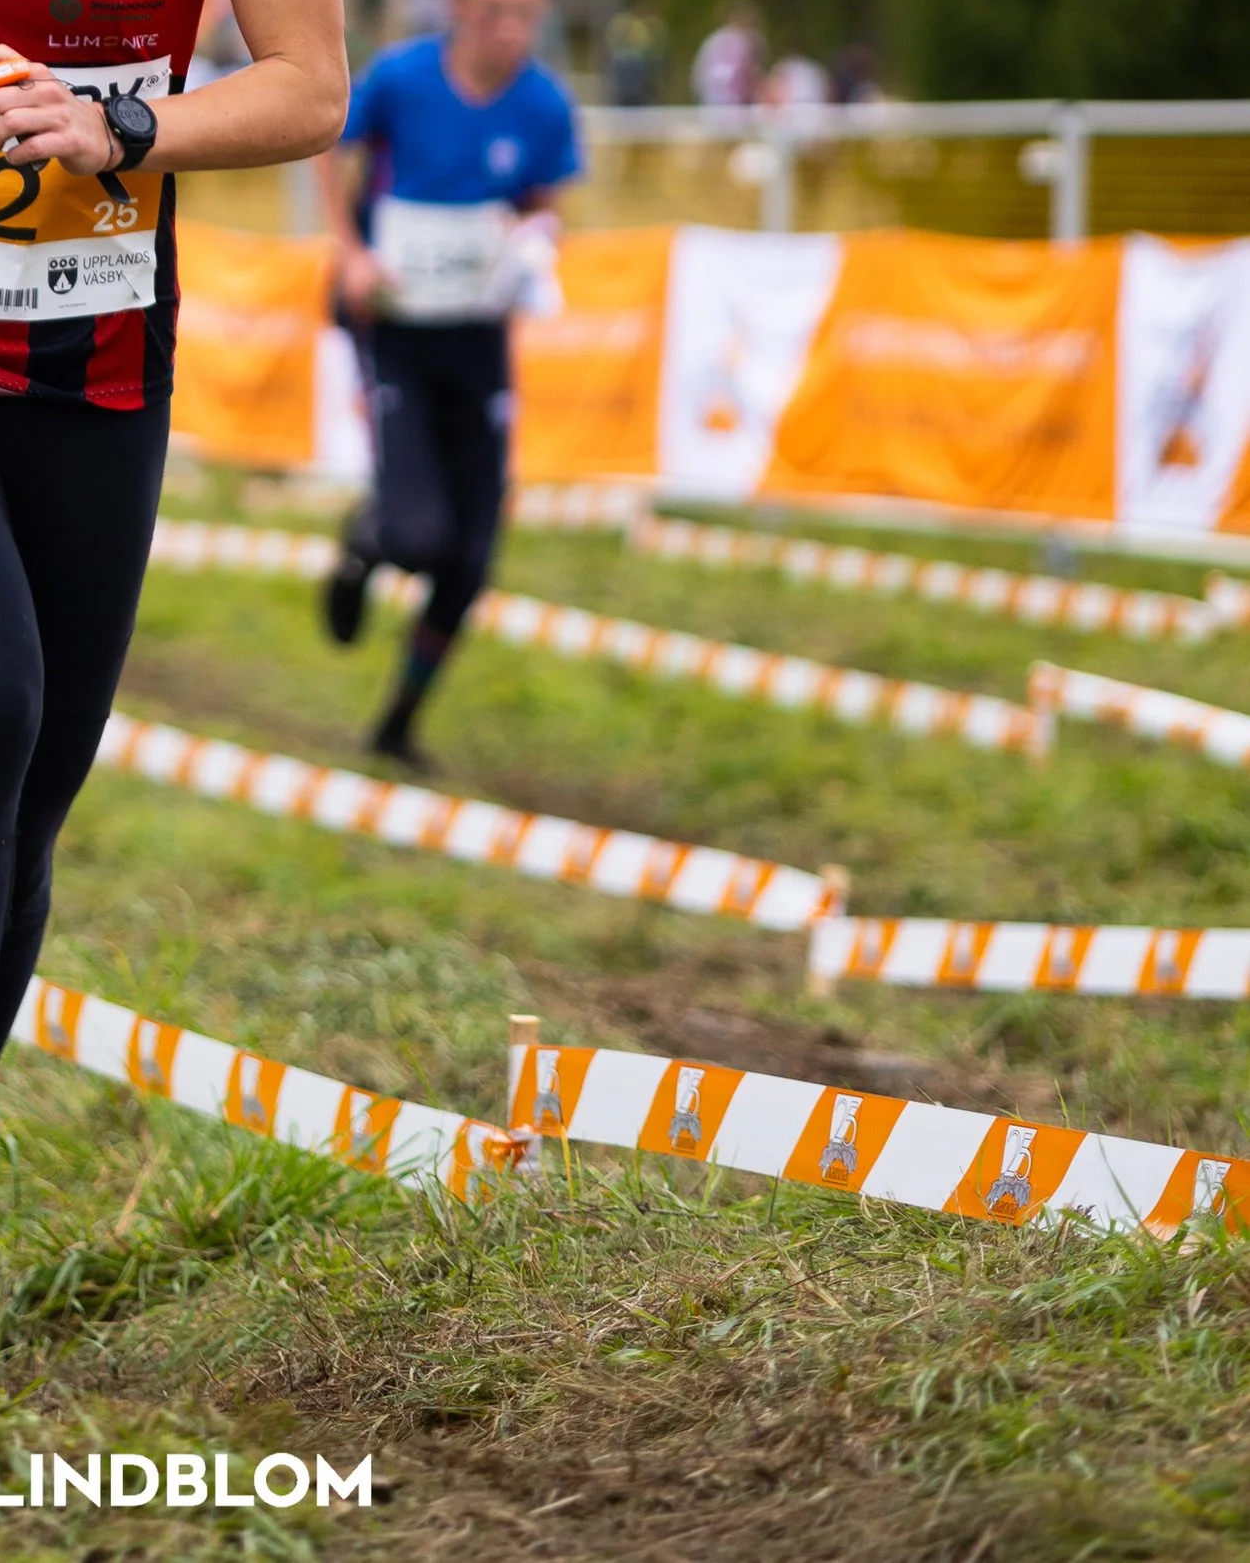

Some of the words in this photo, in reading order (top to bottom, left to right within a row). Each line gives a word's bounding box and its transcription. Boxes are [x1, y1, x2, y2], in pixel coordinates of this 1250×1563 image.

[93, 198, 139, 233] 25
[82, 250, 151, 270] UPPLANDS
[82, 270, 124, 286] VÄSBY
[1004, 1129, 1033, 1181] 25
